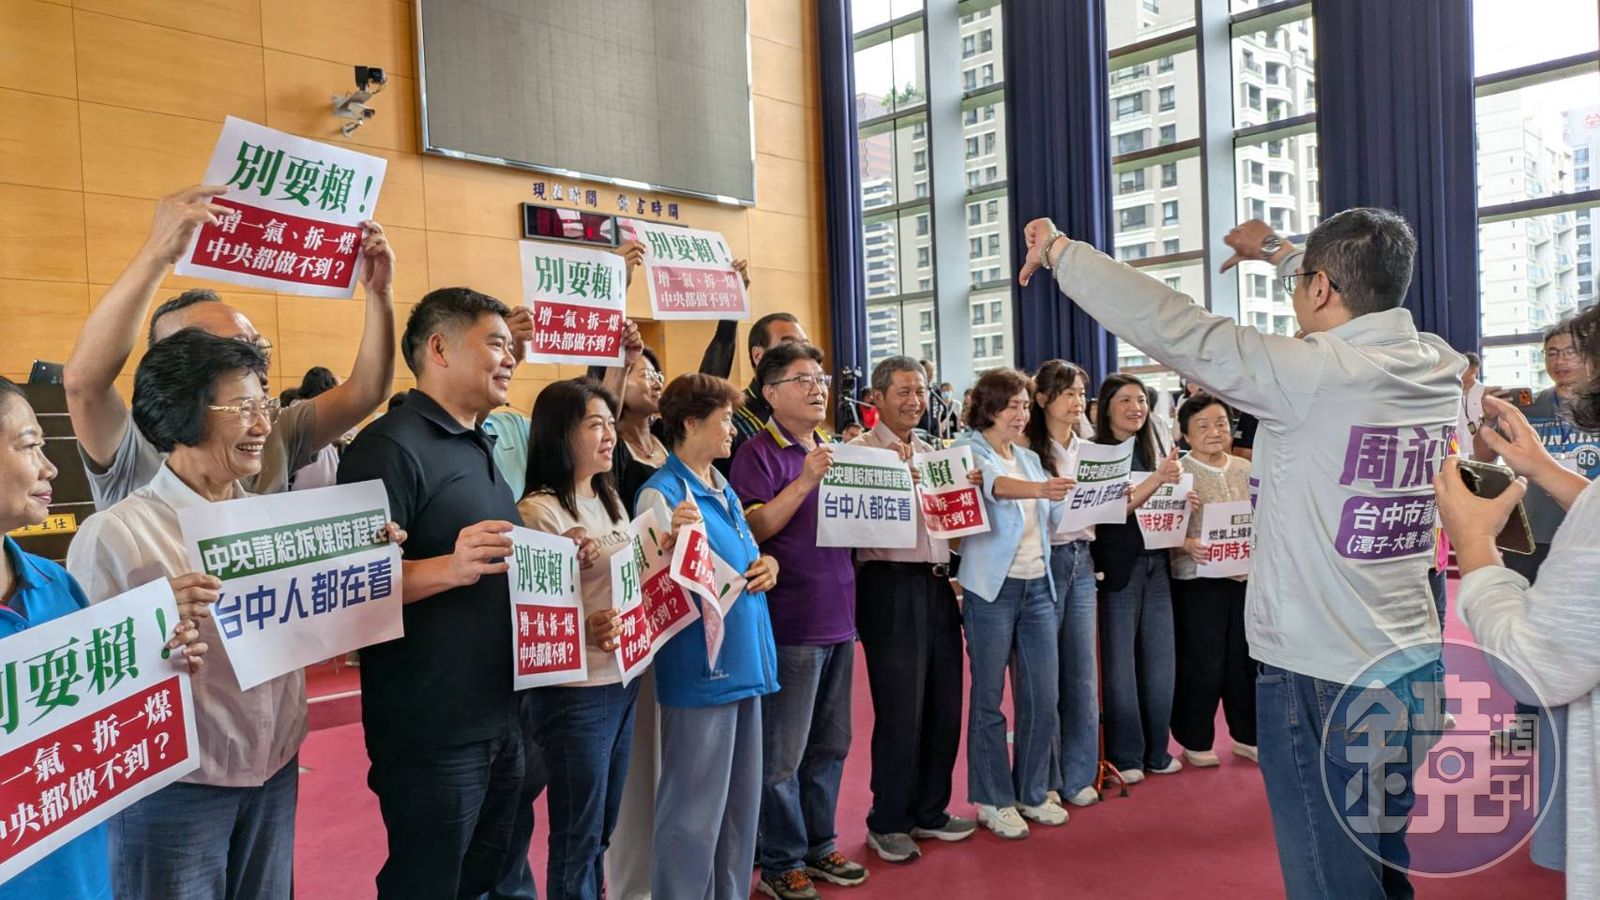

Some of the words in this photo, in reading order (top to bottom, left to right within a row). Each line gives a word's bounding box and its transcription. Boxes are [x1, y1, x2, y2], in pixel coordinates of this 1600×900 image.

[226, 140, 373, 214] 別耍賴！
[206, 237, 345, 281] 中央都做不到？
[645, 230, 730, 264] 別耍賴！
[535, 255, 622, 301] 別耍賴！
[535, 329, 615, 352] 中央都做不到？
[537, 306, 620, 332] 增一氣、拆一煤
[1339, 424, 1456, 489] 周永
[824, 492, 911, 522] 台中人都在看
[203, 512, 388, 577] 中央請給拆煤時程表
[514, 544, 575, 596] 別耍賴！
[213, 556, 392, 641] 台中人都在看
